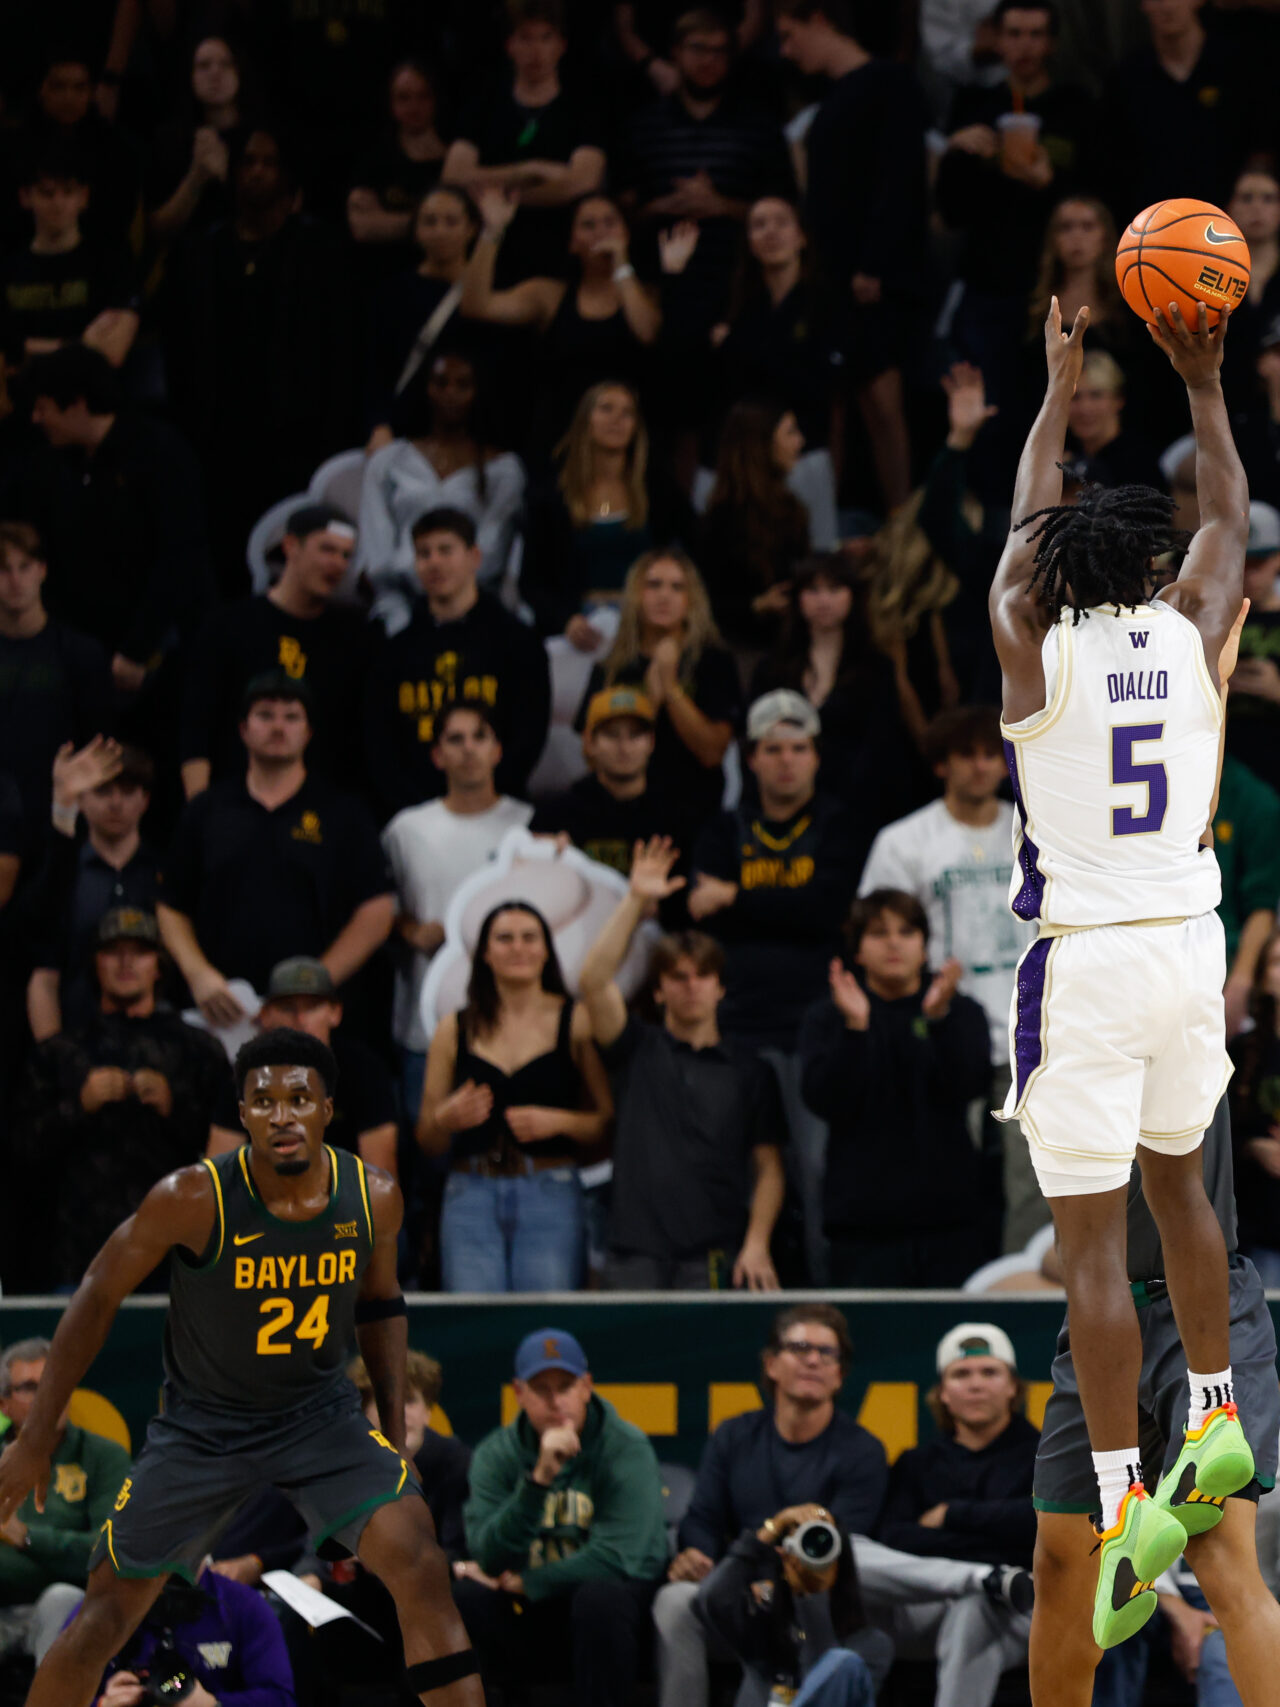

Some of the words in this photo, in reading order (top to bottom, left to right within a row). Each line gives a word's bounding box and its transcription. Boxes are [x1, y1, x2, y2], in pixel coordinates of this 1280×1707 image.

[1197, 265, 1247, 299] ELITE
[1128, 631, 1150, 648] W
[1106, 670, 1169, 703] DIALLO
[1108, 719, 1170, 839] 5
[234, 1248, 358, 1290] BAYLOR
[256, 1293, 331, 1356] 24
